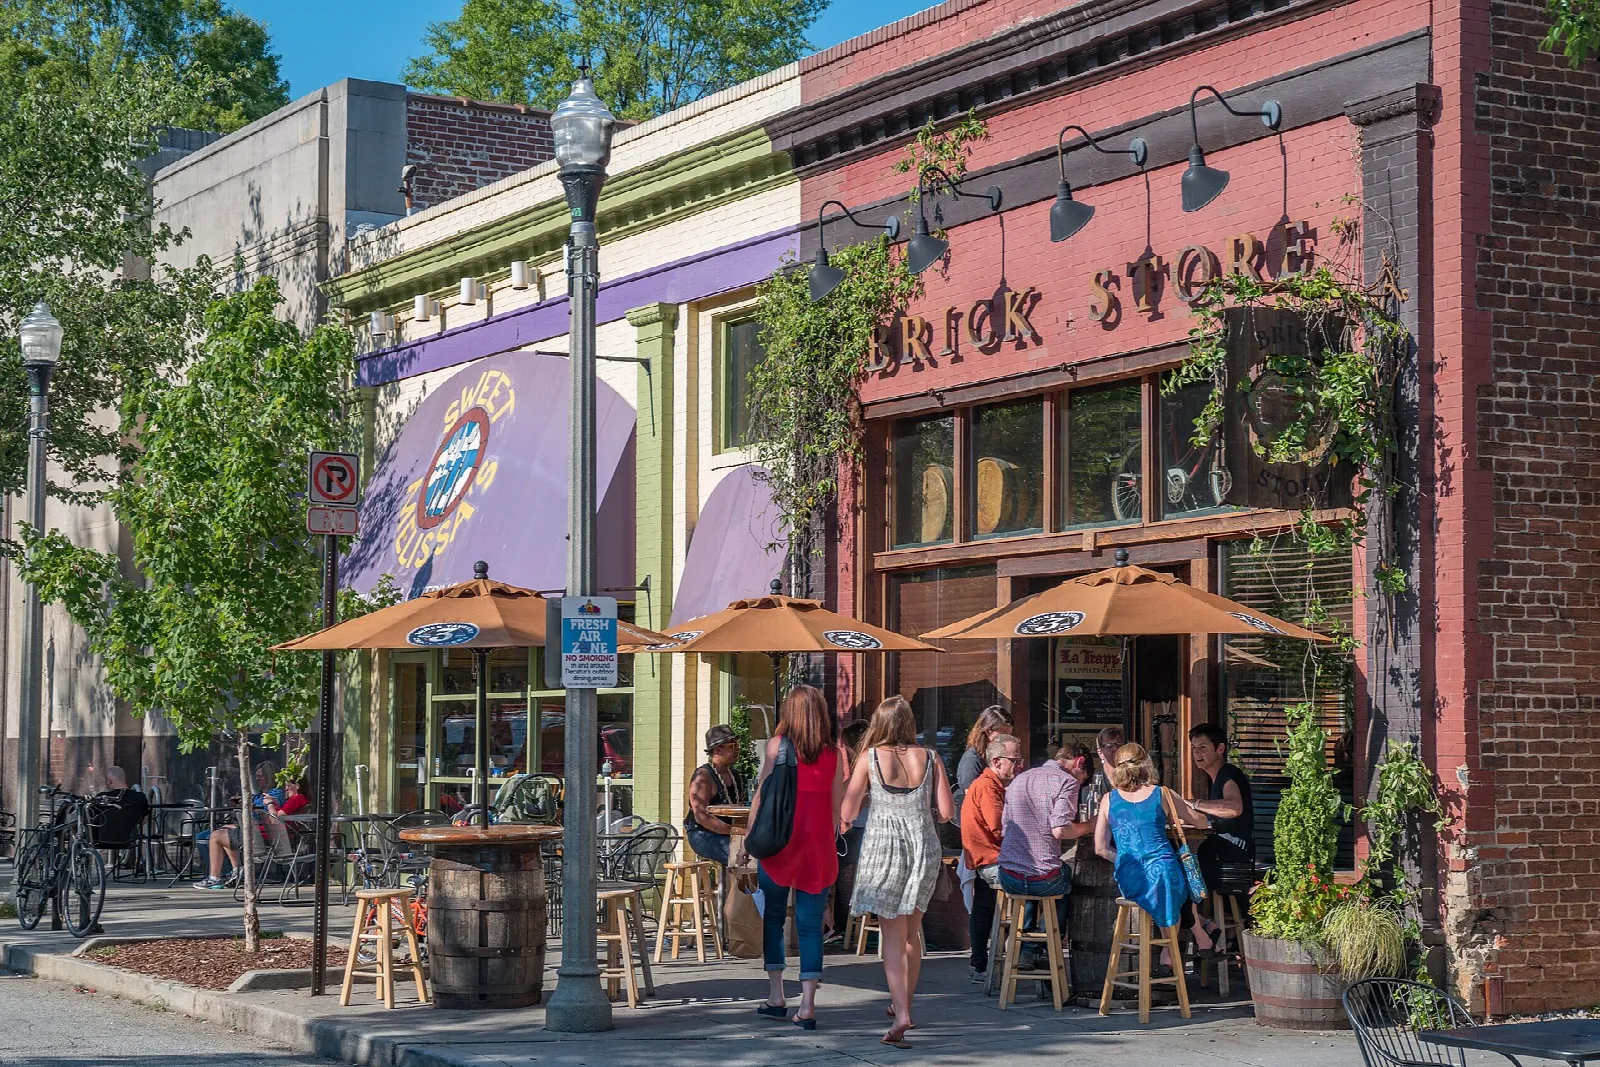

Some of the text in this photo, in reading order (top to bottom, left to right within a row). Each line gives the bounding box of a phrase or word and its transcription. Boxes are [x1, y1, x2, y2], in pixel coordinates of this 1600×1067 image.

[866, 220, 1316, 371] BRICK STORE
[1256, 325, 1317, 351] BRIC
[442, 370, 515, 434] SWEET
[324, 512, 343, 520] AY
[570, 618, 609, 630] FRESH
[579, 631, 601, 641] AIR
[1060, 649, 1121, 668] La Trapp
